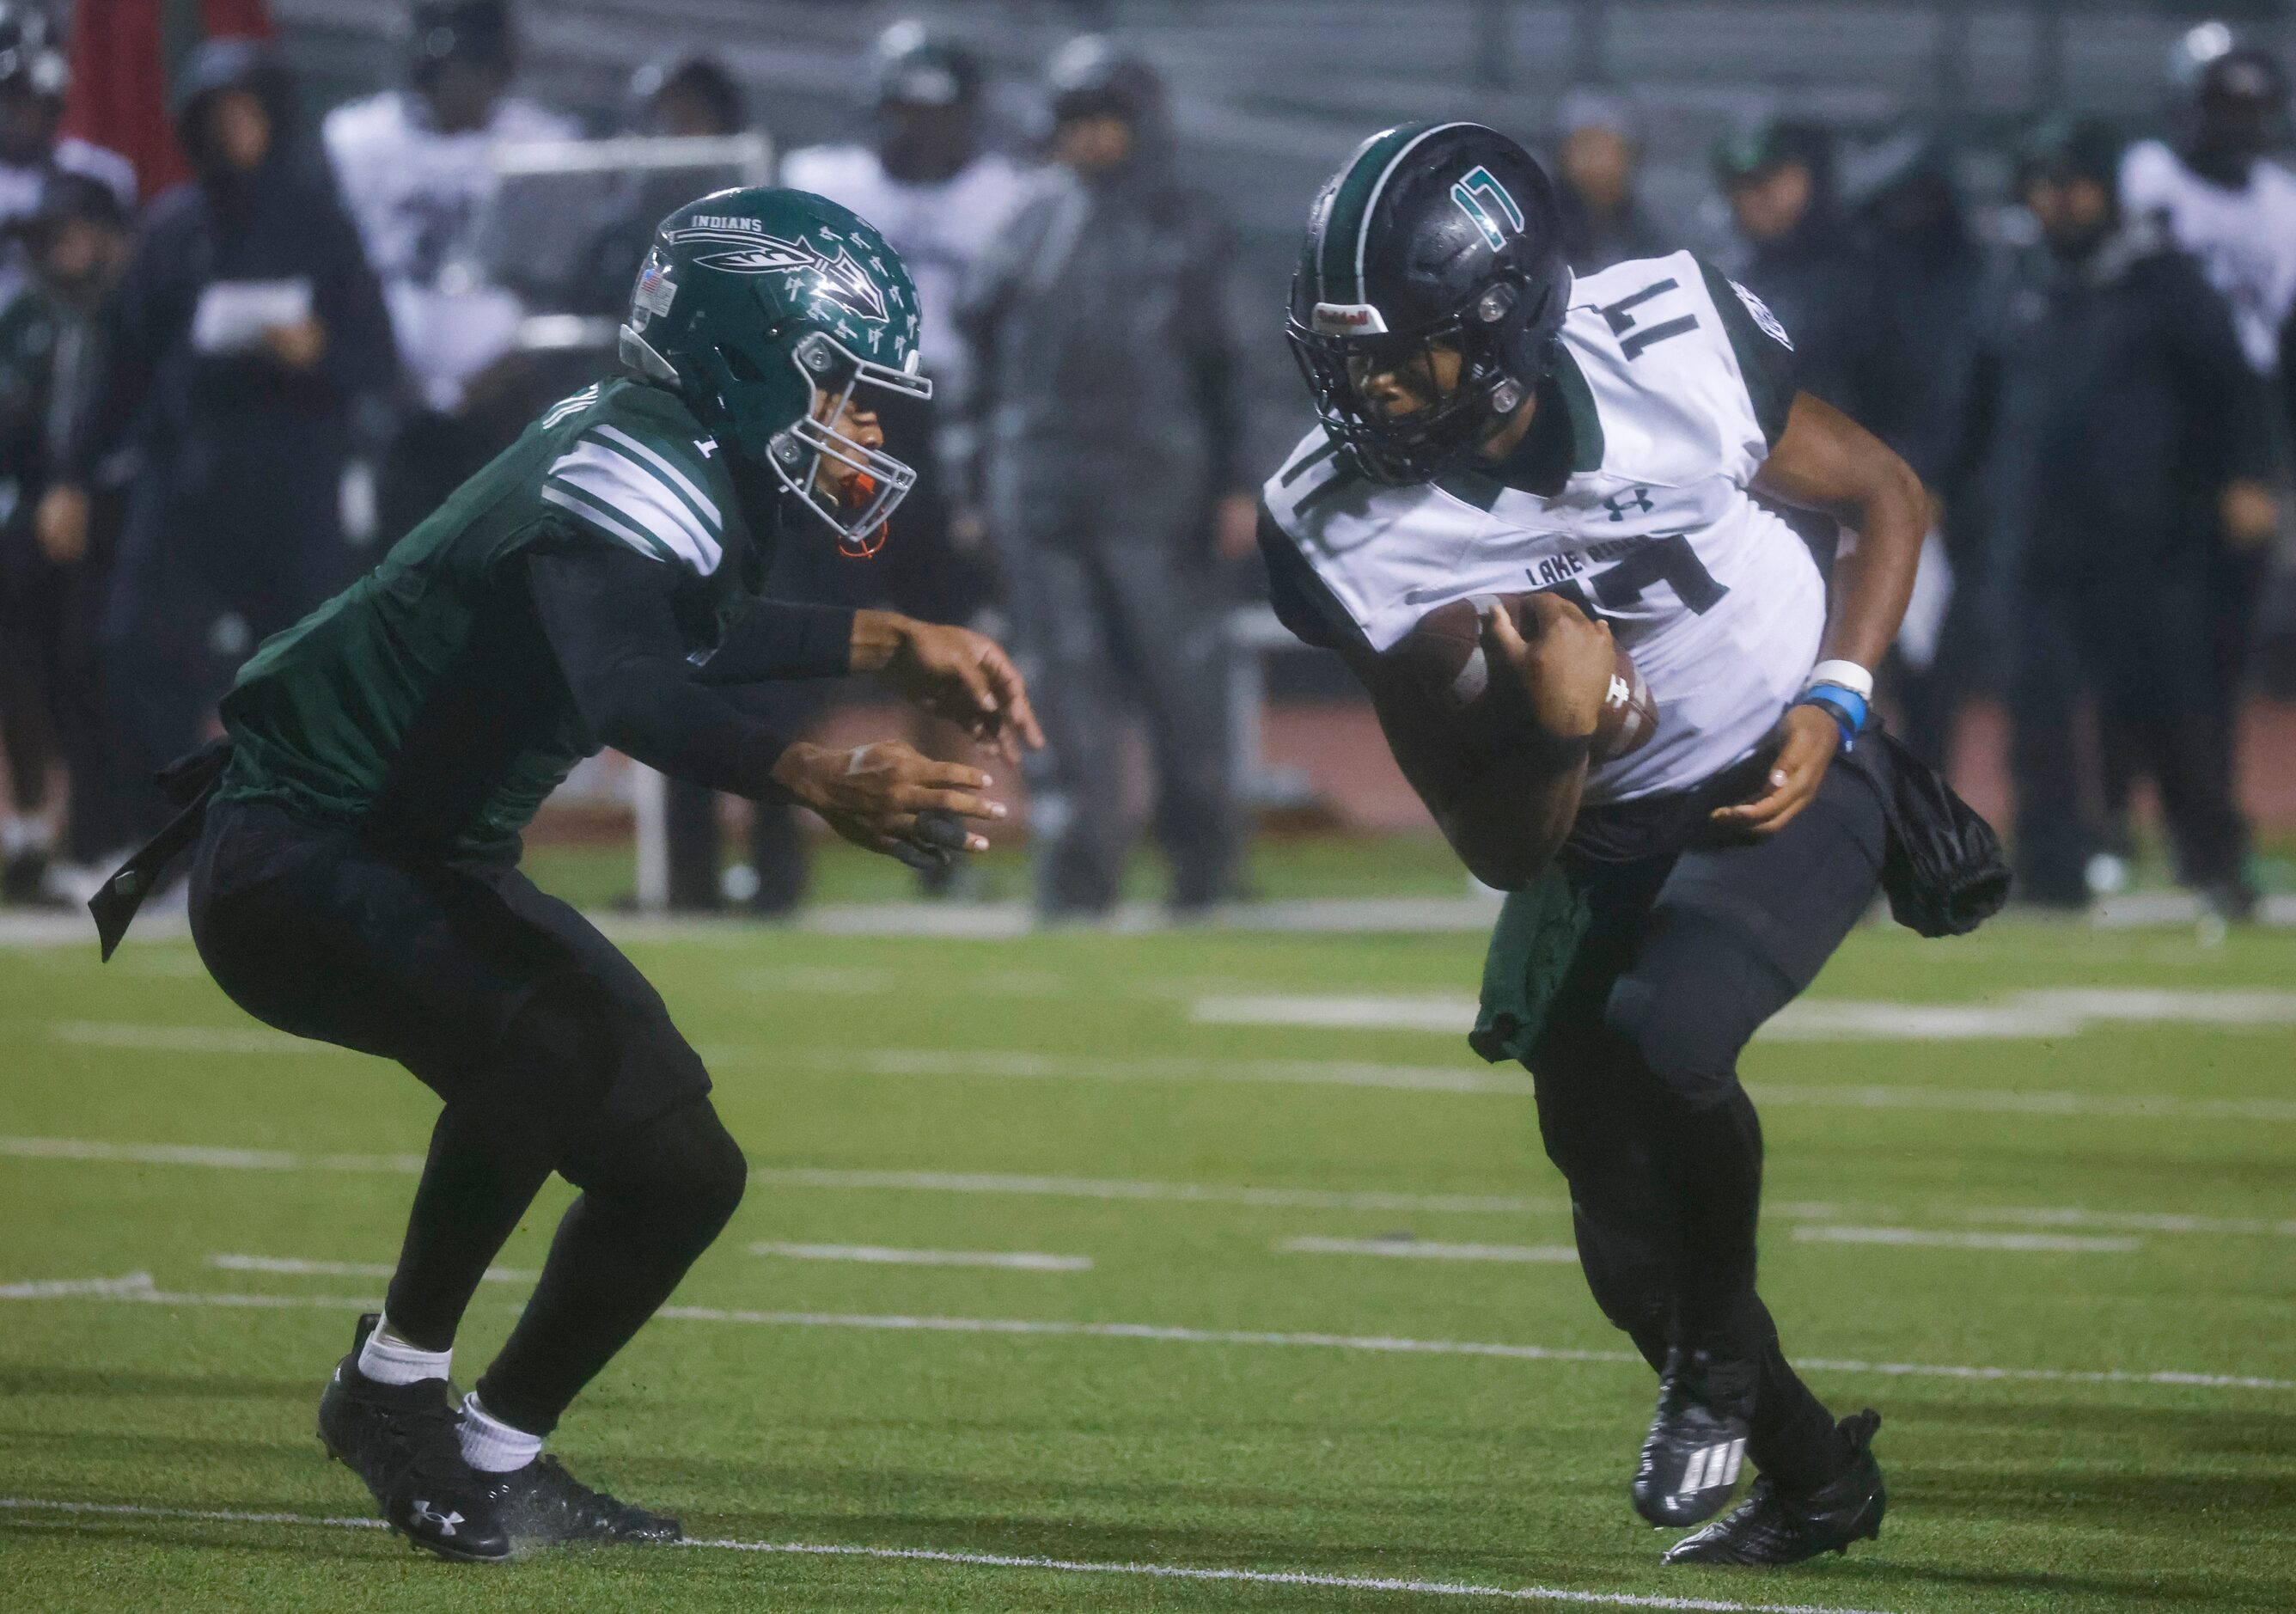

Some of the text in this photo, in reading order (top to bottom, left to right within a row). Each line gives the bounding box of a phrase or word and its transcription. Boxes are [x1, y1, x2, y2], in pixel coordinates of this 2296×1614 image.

[692, 215, 762, 232] INDIANS
[1450, 165, 1524, 253] 17
[1601, 278, 1701, 361] 17
[1525, 550, 1583, 586] LAKE
